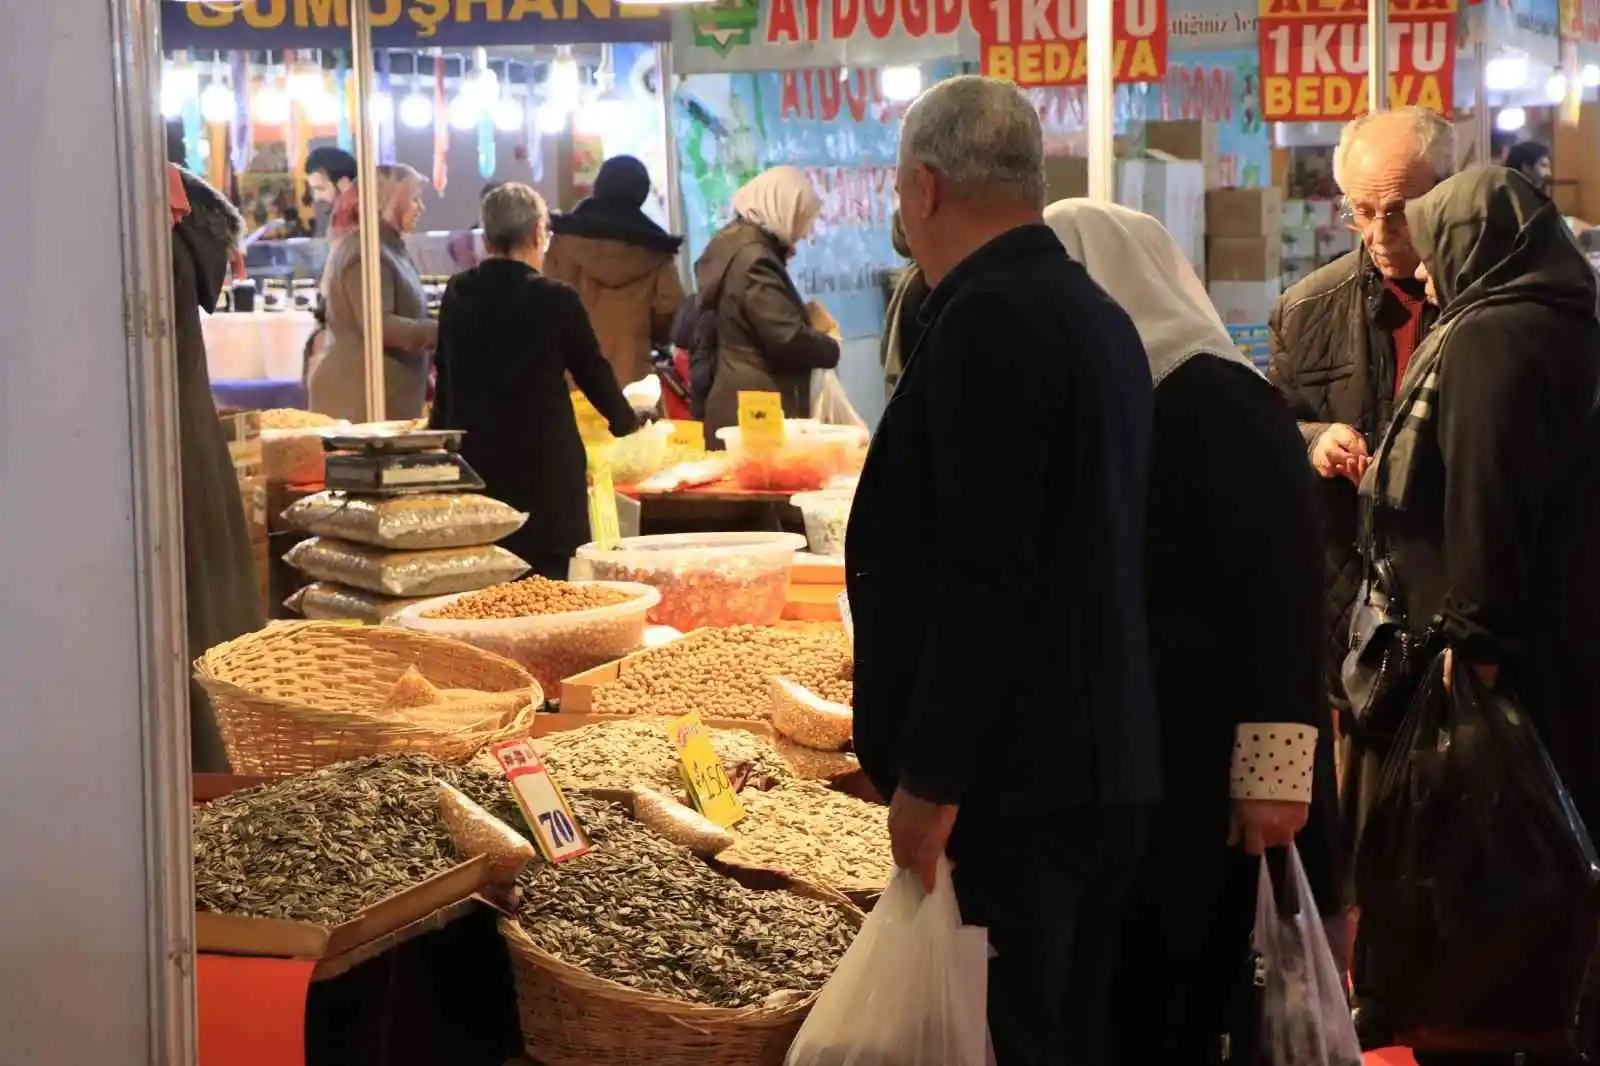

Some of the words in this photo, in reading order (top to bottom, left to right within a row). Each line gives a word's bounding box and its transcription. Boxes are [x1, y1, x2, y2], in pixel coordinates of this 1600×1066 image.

[987, 0, 1011, 43] 1
[1021, 0, 1157, 41] KUU
[1268, 25, 1290, 73] 1
[1301, 22, 1447, 73] KUTU
[1264, 75, 1445, 115] BEDAVA
[537, 809, 575, 849] 70
